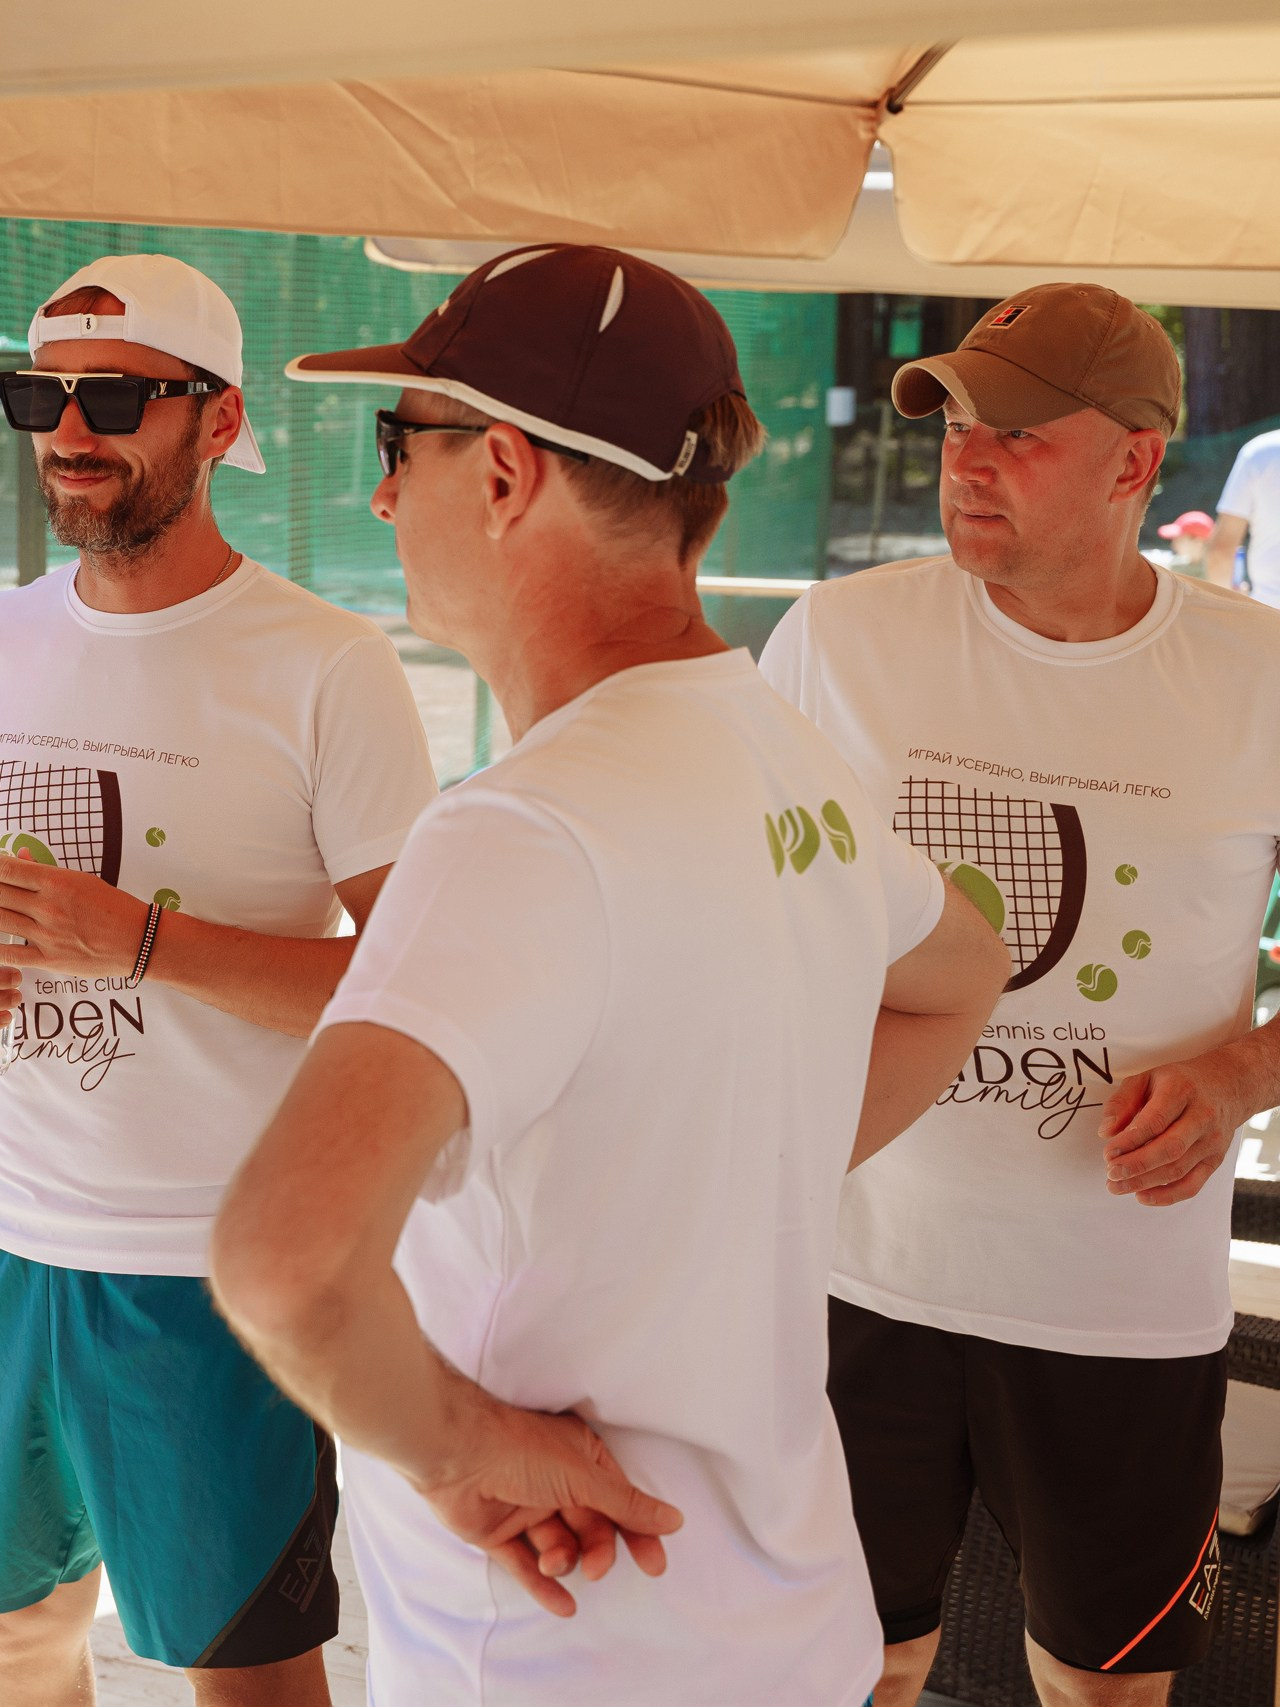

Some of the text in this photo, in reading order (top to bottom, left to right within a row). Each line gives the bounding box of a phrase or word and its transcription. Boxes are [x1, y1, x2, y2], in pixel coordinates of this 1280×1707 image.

[26, 734, 79, 751] УСЕРДНО,
[82, 740, 155, 761] ВЫИГРЫВАЙ
[157, 751, 200, 768] ЛЕГКО
[908, 747, 1171, 799] ИГРАЙ УСЕРДНО, ВЫИГРЫВАЙ ЛЕГКО
[35, 976, 139, 994] tennis club
[981, 1022, 1106, 1041] ennis club
[11, 1022, 136, 1092] amily
[936, 1071, 1103, 1140] amily
